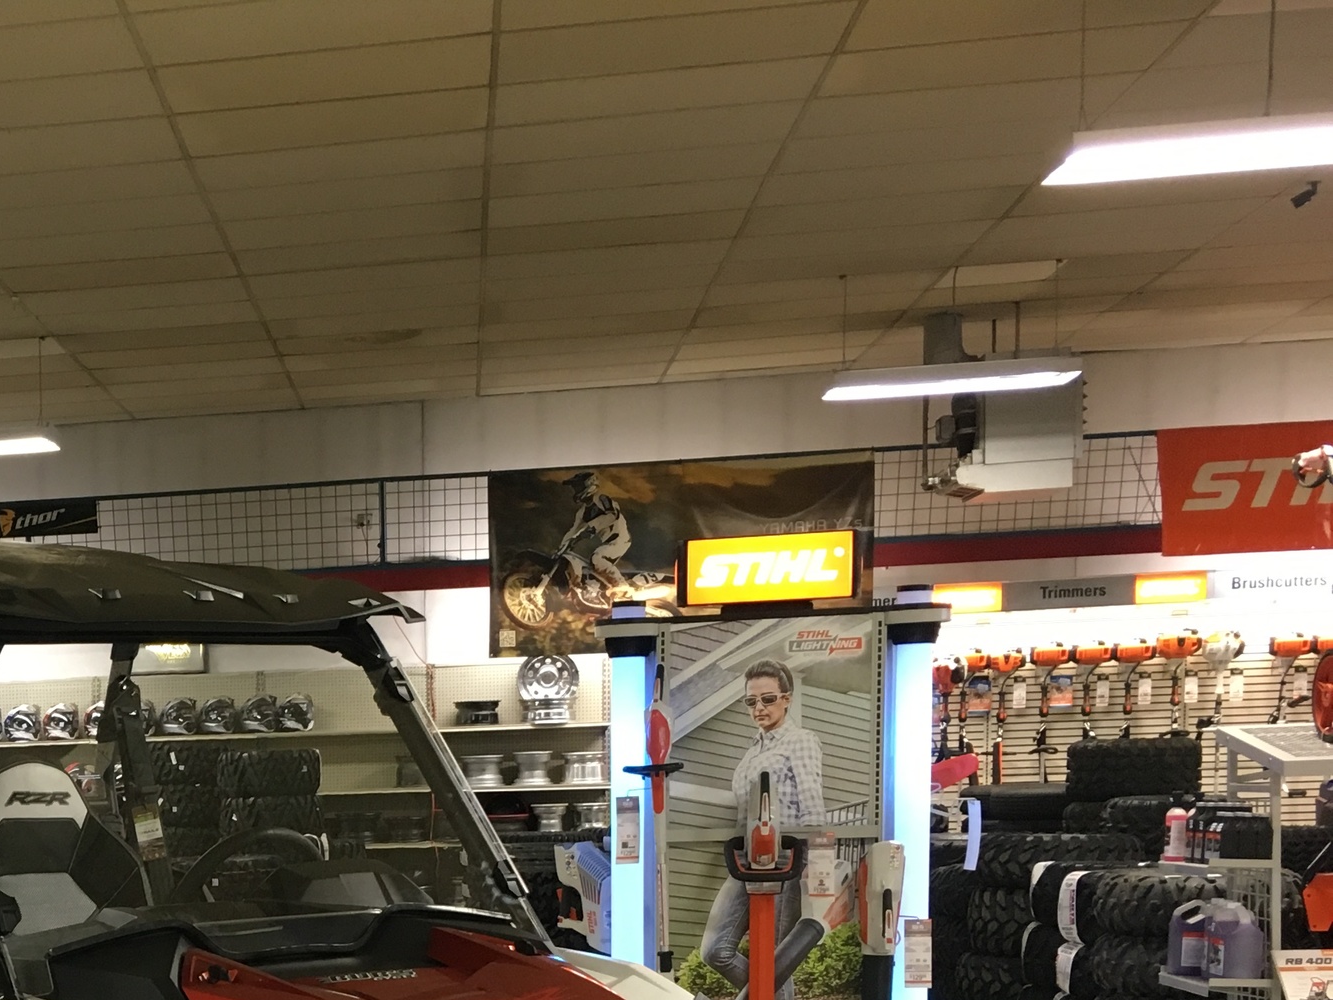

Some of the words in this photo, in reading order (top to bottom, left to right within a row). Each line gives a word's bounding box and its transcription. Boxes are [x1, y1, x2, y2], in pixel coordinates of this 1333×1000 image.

[1181, 456, 1333, 512] STI
[15, 508, 66, 530] thor
[760, 519, 827, 533] YAMAHA
[695, 548, 840, 588] STIHL
[1231, 576, 1327, 590] Brushcutters
[1040, 585, 1107, 599] Trimmers
[796, 630, 833, 639] STIHL
[791, 636, 859, 651] LIGHTNING
[5, 791, 71, 807] RZR
[586, 910, 596, 934] STIHL
[1285, 957, 1303, 965] RB
[1306, 957, 1333, 965] 400
